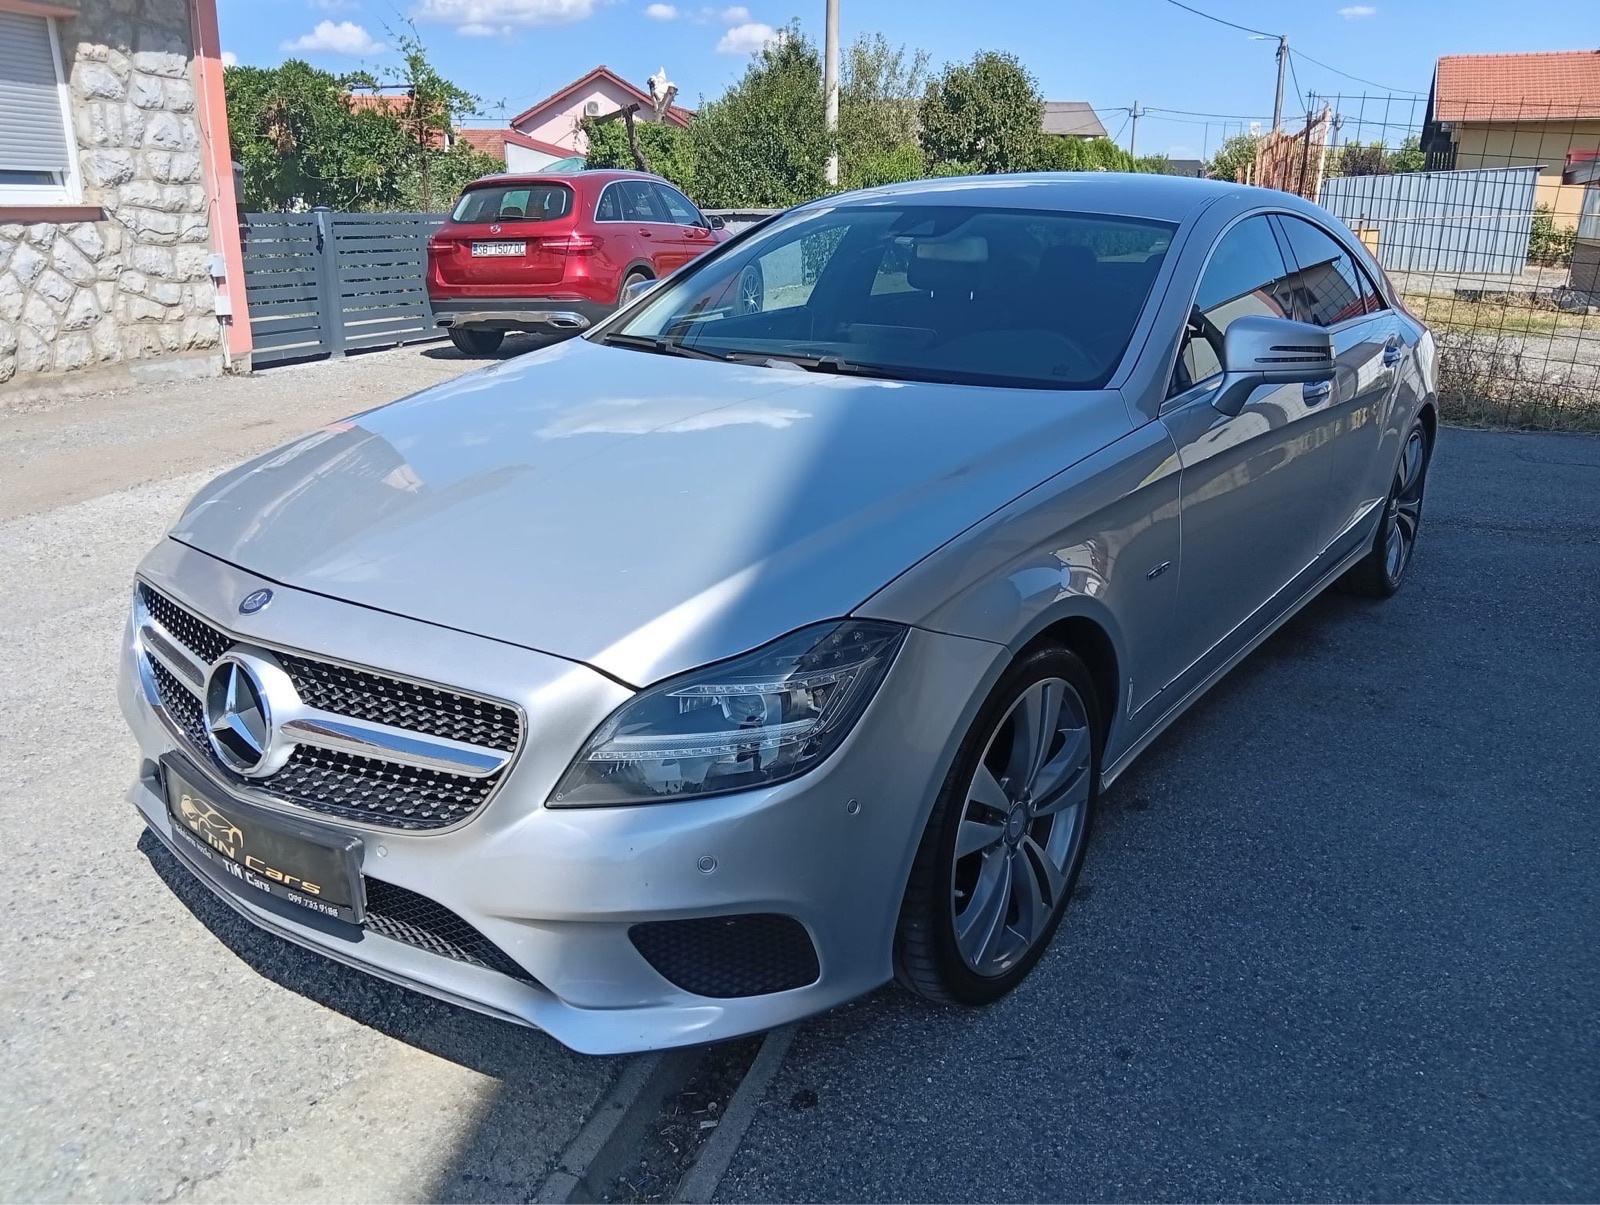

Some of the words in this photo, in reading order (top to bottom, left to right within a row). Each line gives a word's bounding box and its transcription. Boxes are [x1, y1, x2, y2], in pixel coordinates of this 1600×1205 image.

[478, 244, 488, 254] SB
[494, 243, 512, 254] 1507
[245, 855, 321, 895] Cars
[245, 871, 271, 893] Cars
[287, 892, 302, 905] 099
